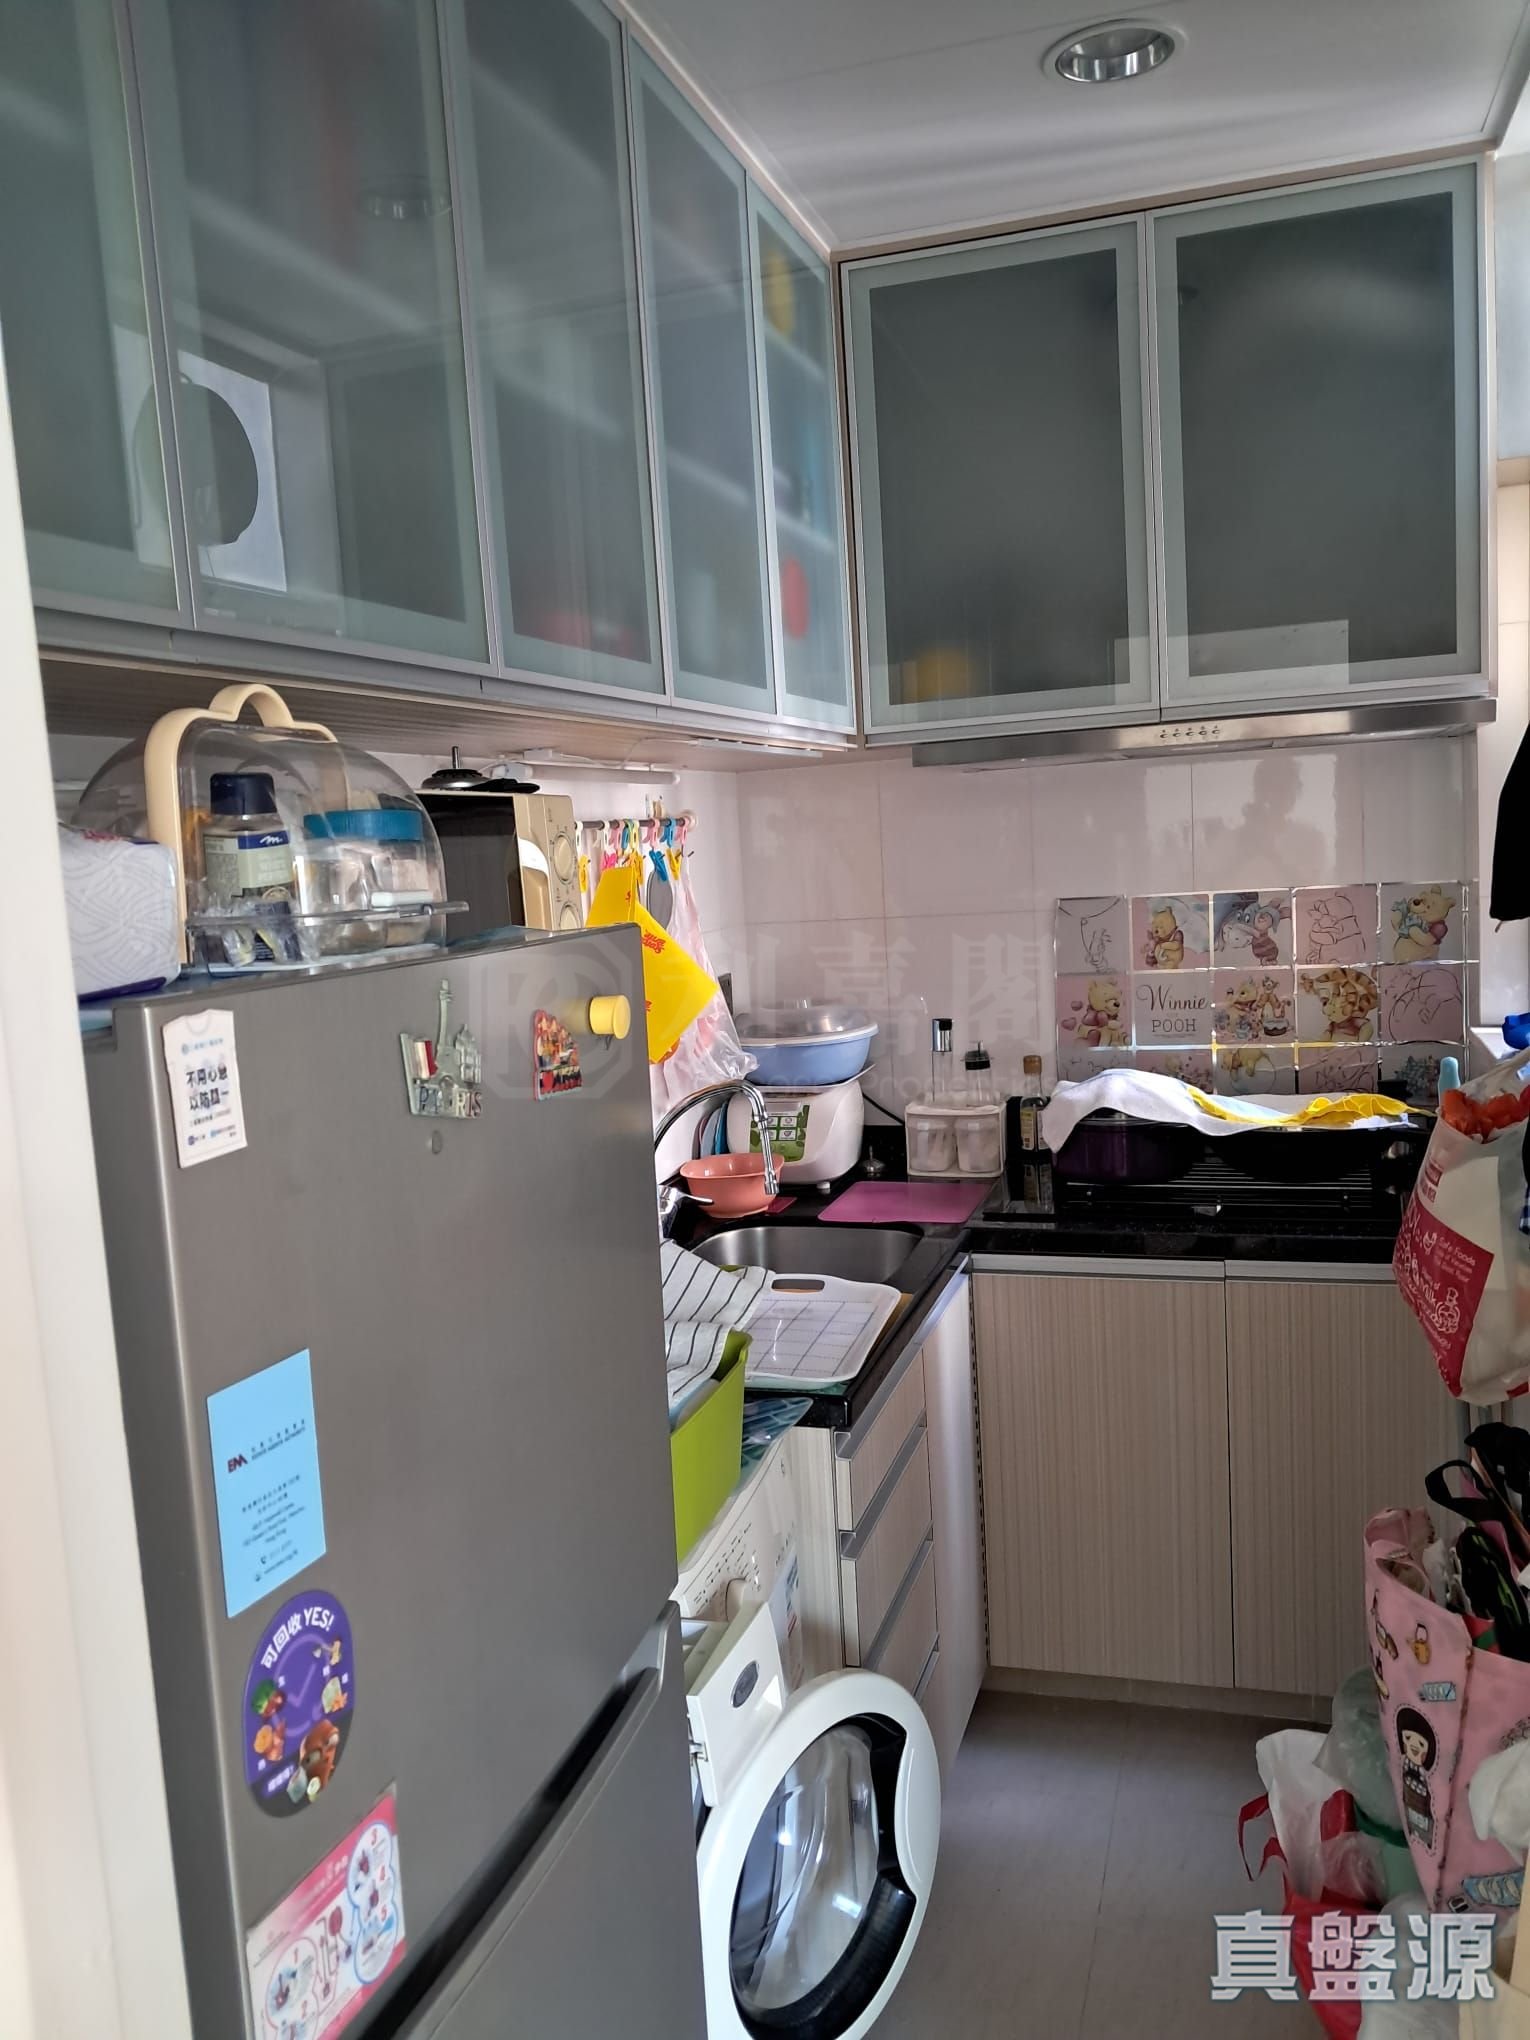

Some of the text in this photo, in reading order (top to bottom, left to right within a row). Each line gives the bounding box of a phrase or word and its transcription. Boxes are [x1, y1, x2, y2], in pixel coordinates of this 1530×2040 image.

[1136, 984, 1208, 1011] Winnie
[1151, 1018, 1197, 1033] POOH
[260, 1606, 335, 1669] 可回收 YES!
